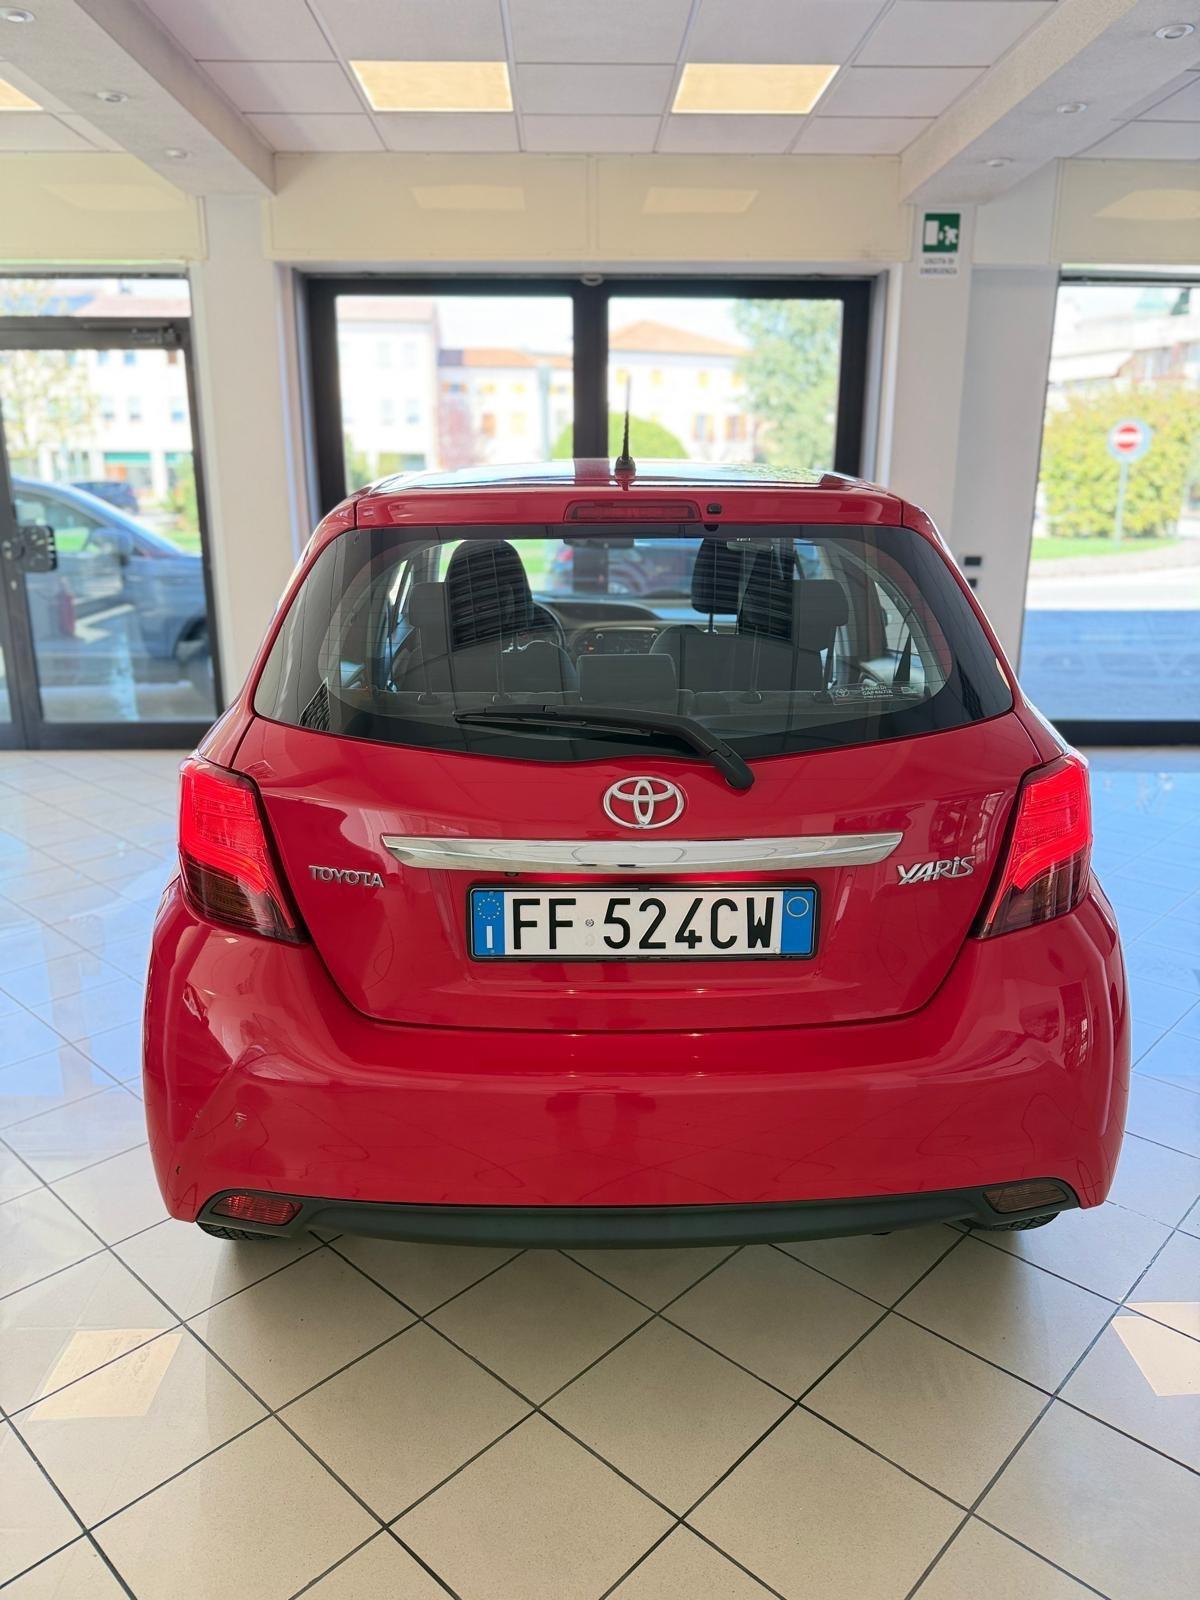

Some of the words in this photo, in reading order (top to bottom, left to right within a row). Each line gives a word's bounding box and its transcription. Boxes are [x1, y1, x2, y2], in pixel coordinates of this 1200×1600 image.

[308, 865, 384, 888] TOYOTA
[897, 856, 976, 886] YARIS
[486, 925, 493, 949] I
[512, 898, 576, 950] FF
[603, 897, 775, 949] 524CW
